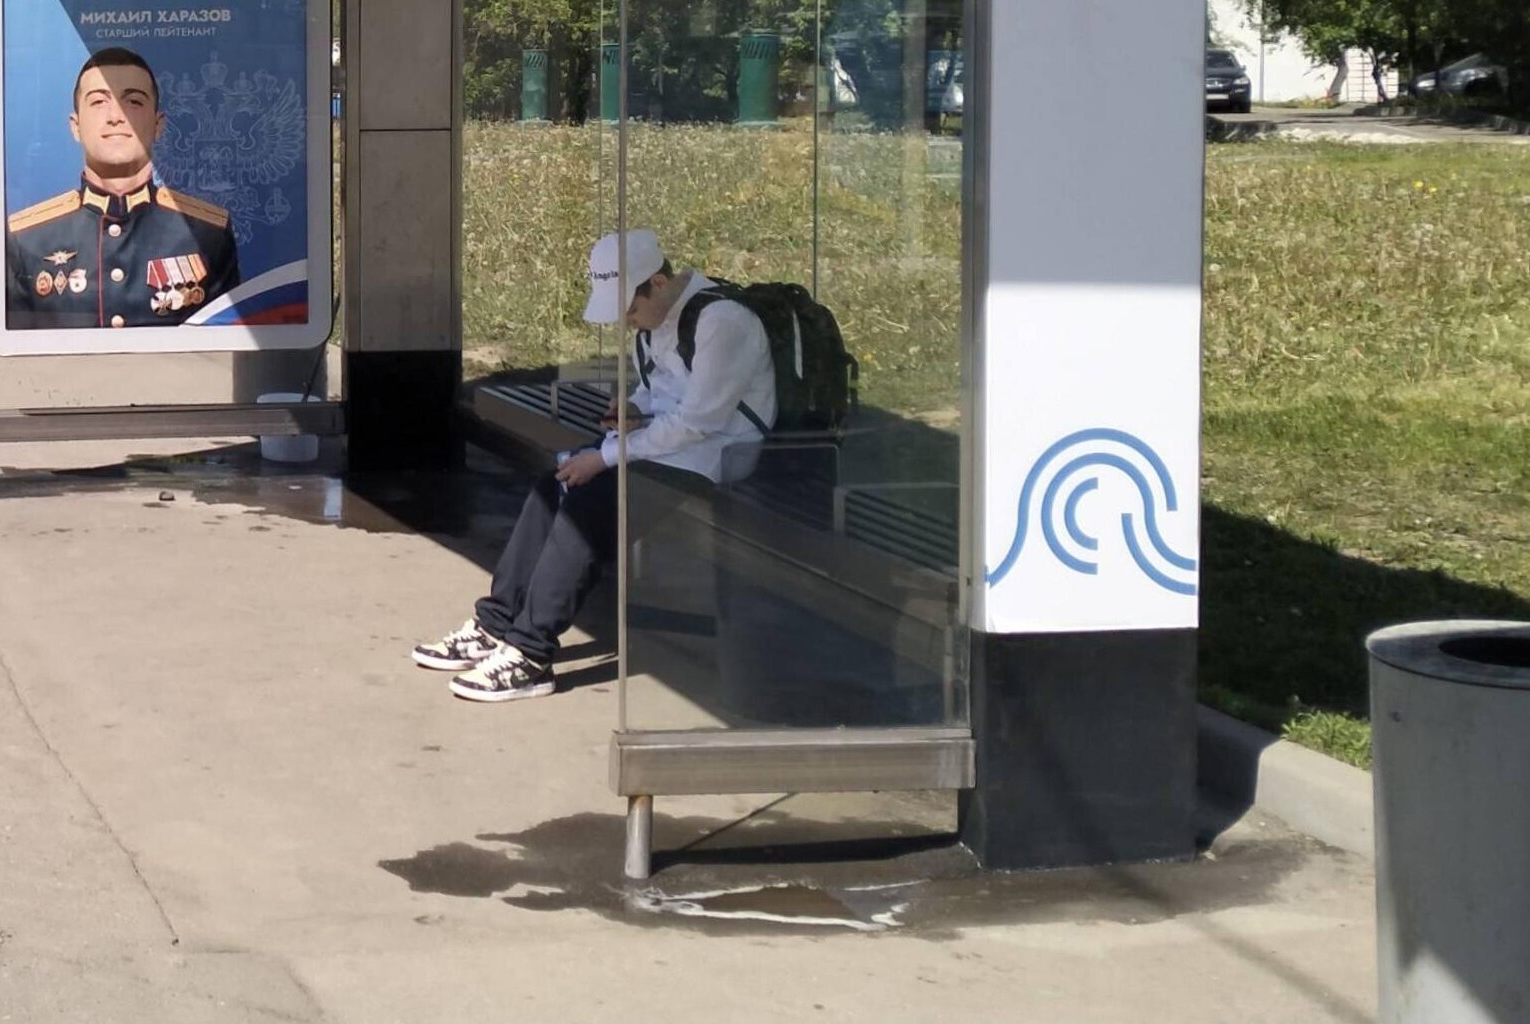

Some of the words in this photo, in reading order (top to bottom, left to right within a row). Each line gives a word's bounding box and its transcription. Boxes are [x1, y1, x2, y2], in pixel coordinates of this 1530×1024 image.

[80, 11, 152, 25] МИХАИЛ
[157, 9, 232, 23] ХАРАЗОВ
[95, 26, 150, 39] СТАРШИЙ
[153, 26, 217, 38] ЛЕЙТЕНАНТ
